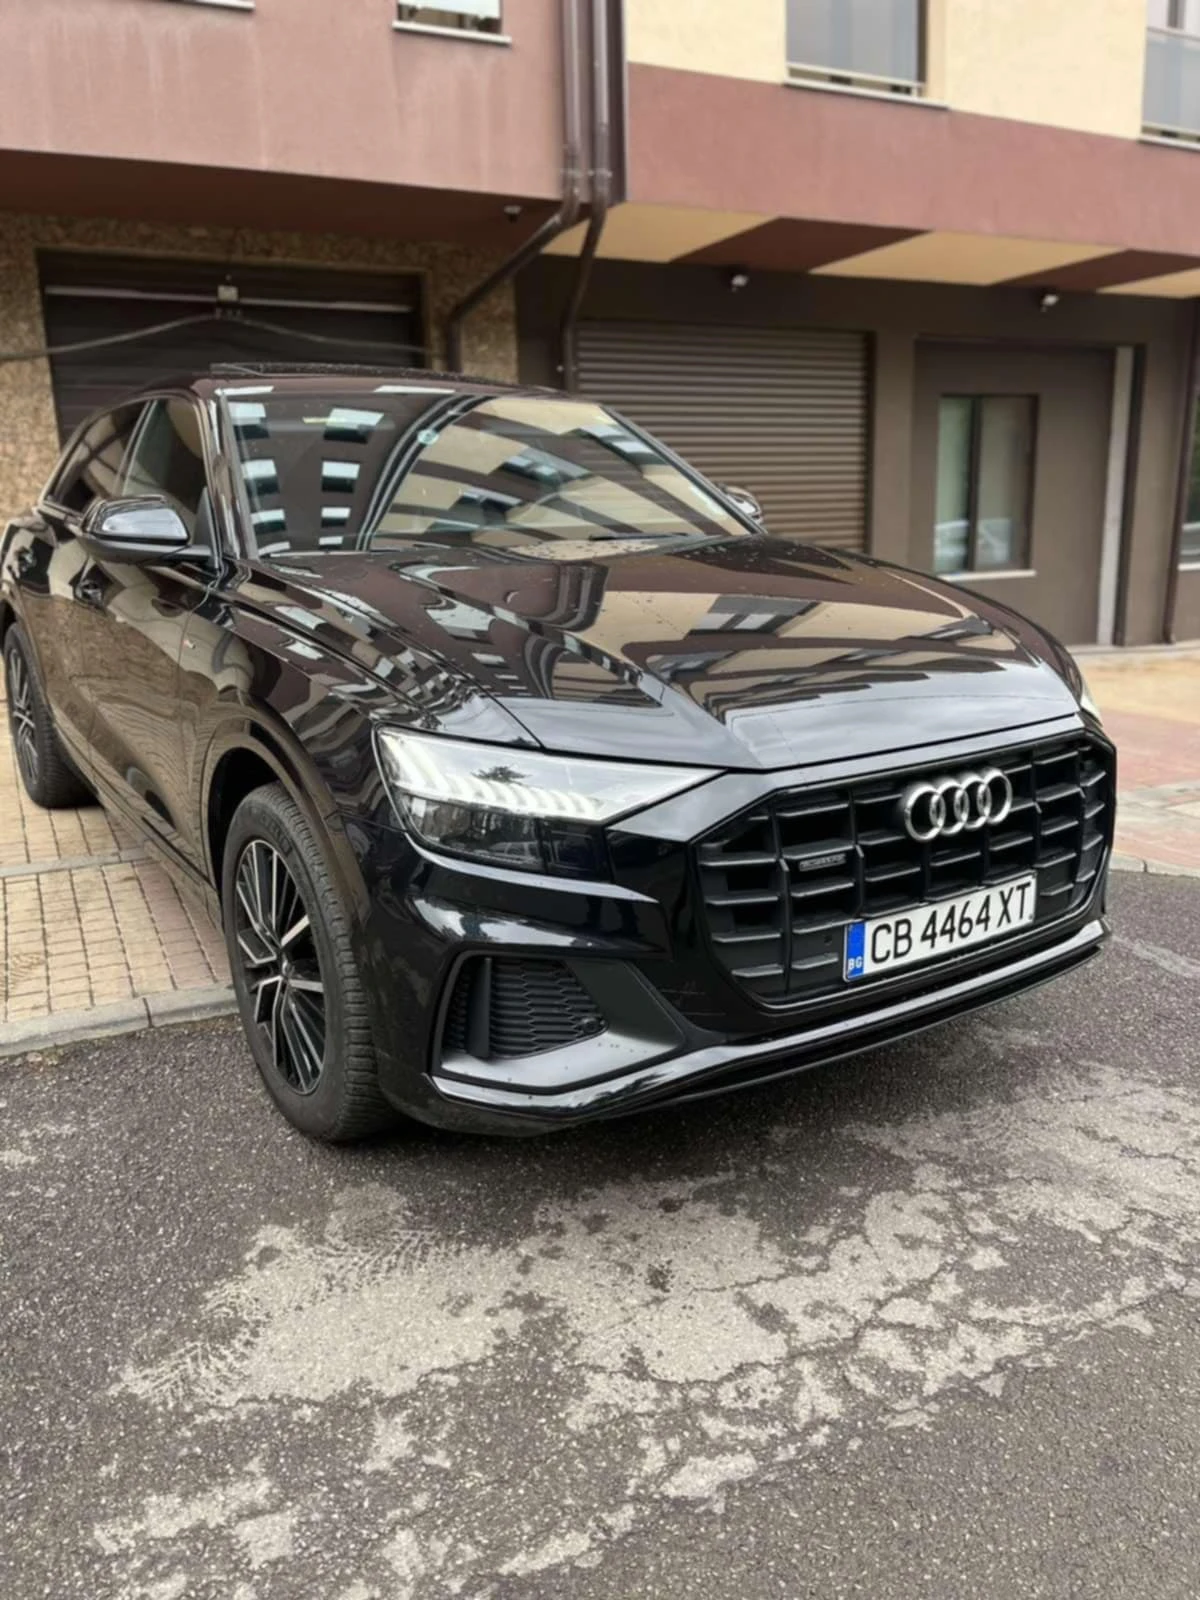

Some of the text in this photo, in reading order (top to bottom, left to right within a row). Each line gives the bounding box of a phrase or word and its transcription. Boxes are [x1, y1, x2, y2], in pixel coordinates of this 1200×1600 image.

[871, 882, 1032, 964] CB 4464 XT
[848, 956, 863, 971] BG
